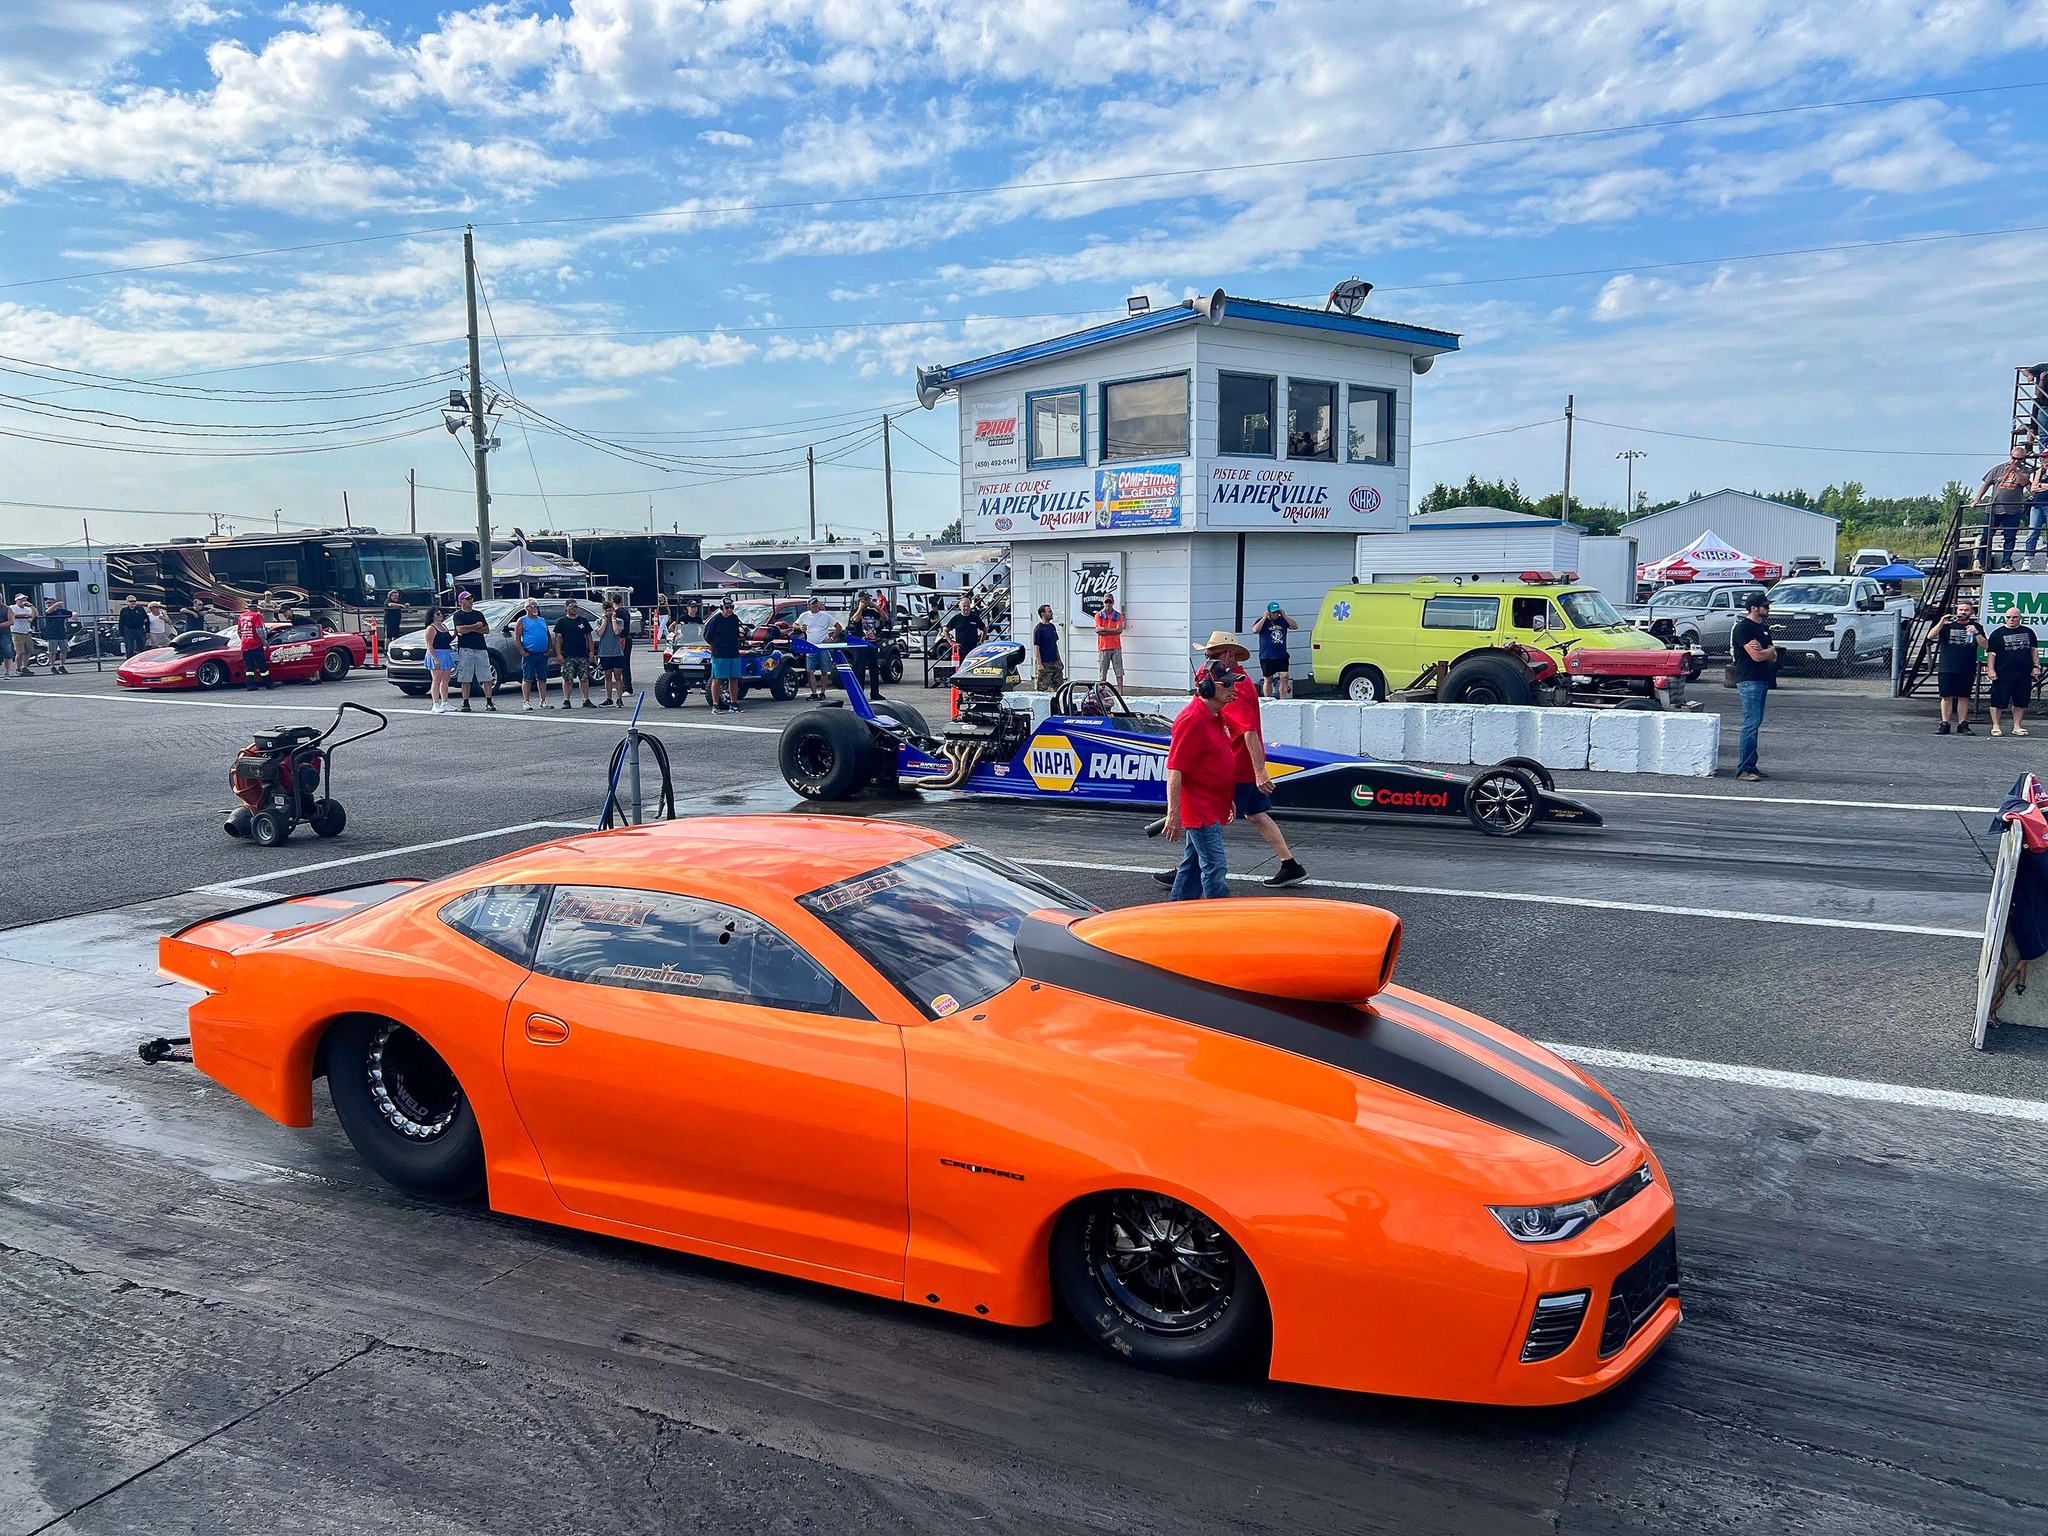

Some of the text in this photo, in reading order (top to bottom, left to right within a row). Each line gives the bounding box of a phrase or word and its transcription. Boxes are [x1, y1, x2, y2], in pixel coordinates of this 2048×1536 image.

[991, 458, 1017, 467] 492-0141
[1118, 470, 1177, 488] COMPÉTITION
[1212, 468, 1295, 485] PISTE DE COURSE
[978, 479, 1052, 495] PISTE DE COURSE
[1131, 486, 1176, 498] GÉLINAS
[977, 490, 1091, 521] NAPIERVILLE
[1212, 483, 1329, 513] NAPIERVILLE
[1352, 489, 1378, 509] NHRA
[1040, 511, 1092, 530] DRAGWAY
[1282, 506, 1332, 524] DRAGWAY
[1699, 549, 1737, 562] NHRA
[1071, 566, 1120, 595] Crête
[1986, 615, 2048, 626] NAERV
[1032, 750, 1073, 776] NAPA
[1088, 752, 1168, 782] RACIN
[1376, 788, 1448, 807] Castrol
[817, 869, 910, 913] 1826X
[551, 896, 657, 928] 1826X
[611, 963, 643, 979] KEV
[937, 1001, 957, 1014] KING
[397, 1084, 429, 1116] WELD
[1084, 1213, 1147, 1332] WELD RACING
